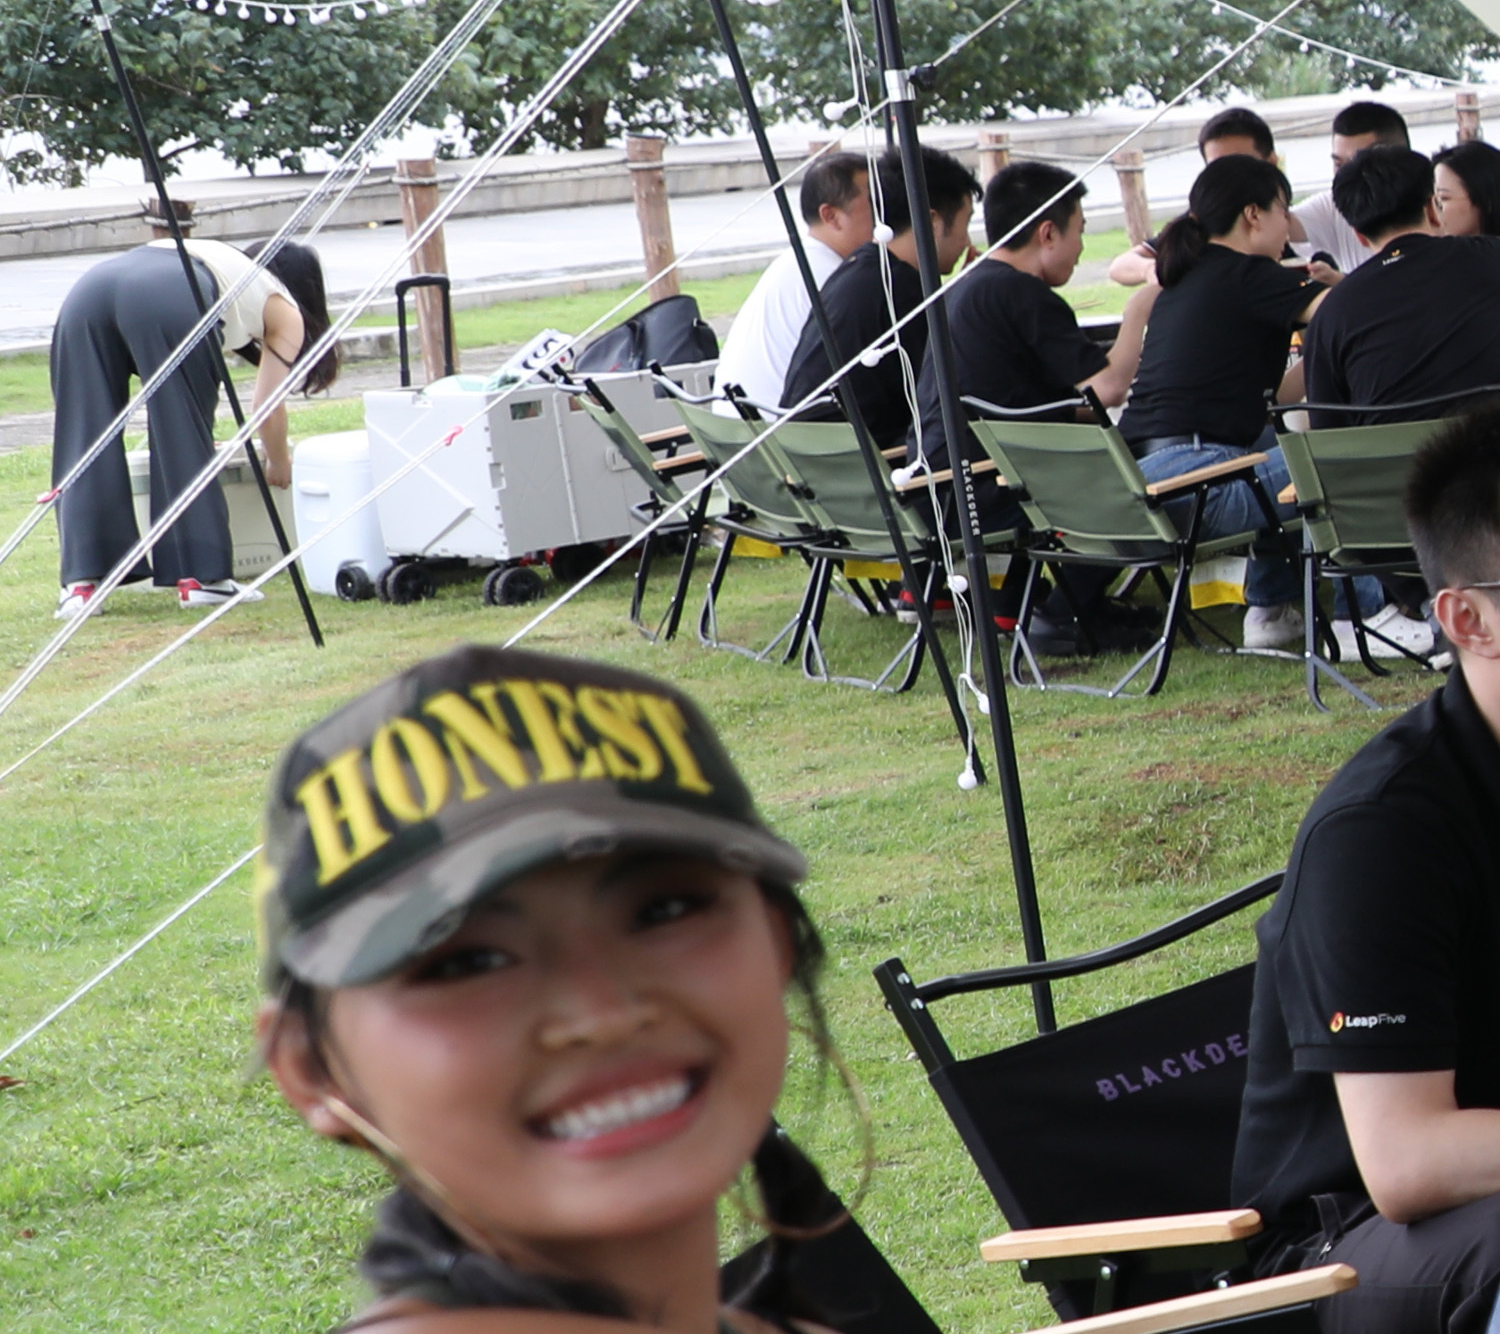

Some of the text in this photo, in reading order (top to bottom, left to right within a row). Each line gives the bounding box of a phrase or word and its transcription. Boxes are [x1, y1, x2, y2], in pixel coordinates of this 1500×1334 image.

[961, 459, 981, 536] BLACKDEER
[297, 678, 714, 886] HONEST
[1345, 1012, 1406, 1029] LeapFive
[1096, 1033, 1249, 1101] BLACKDE
